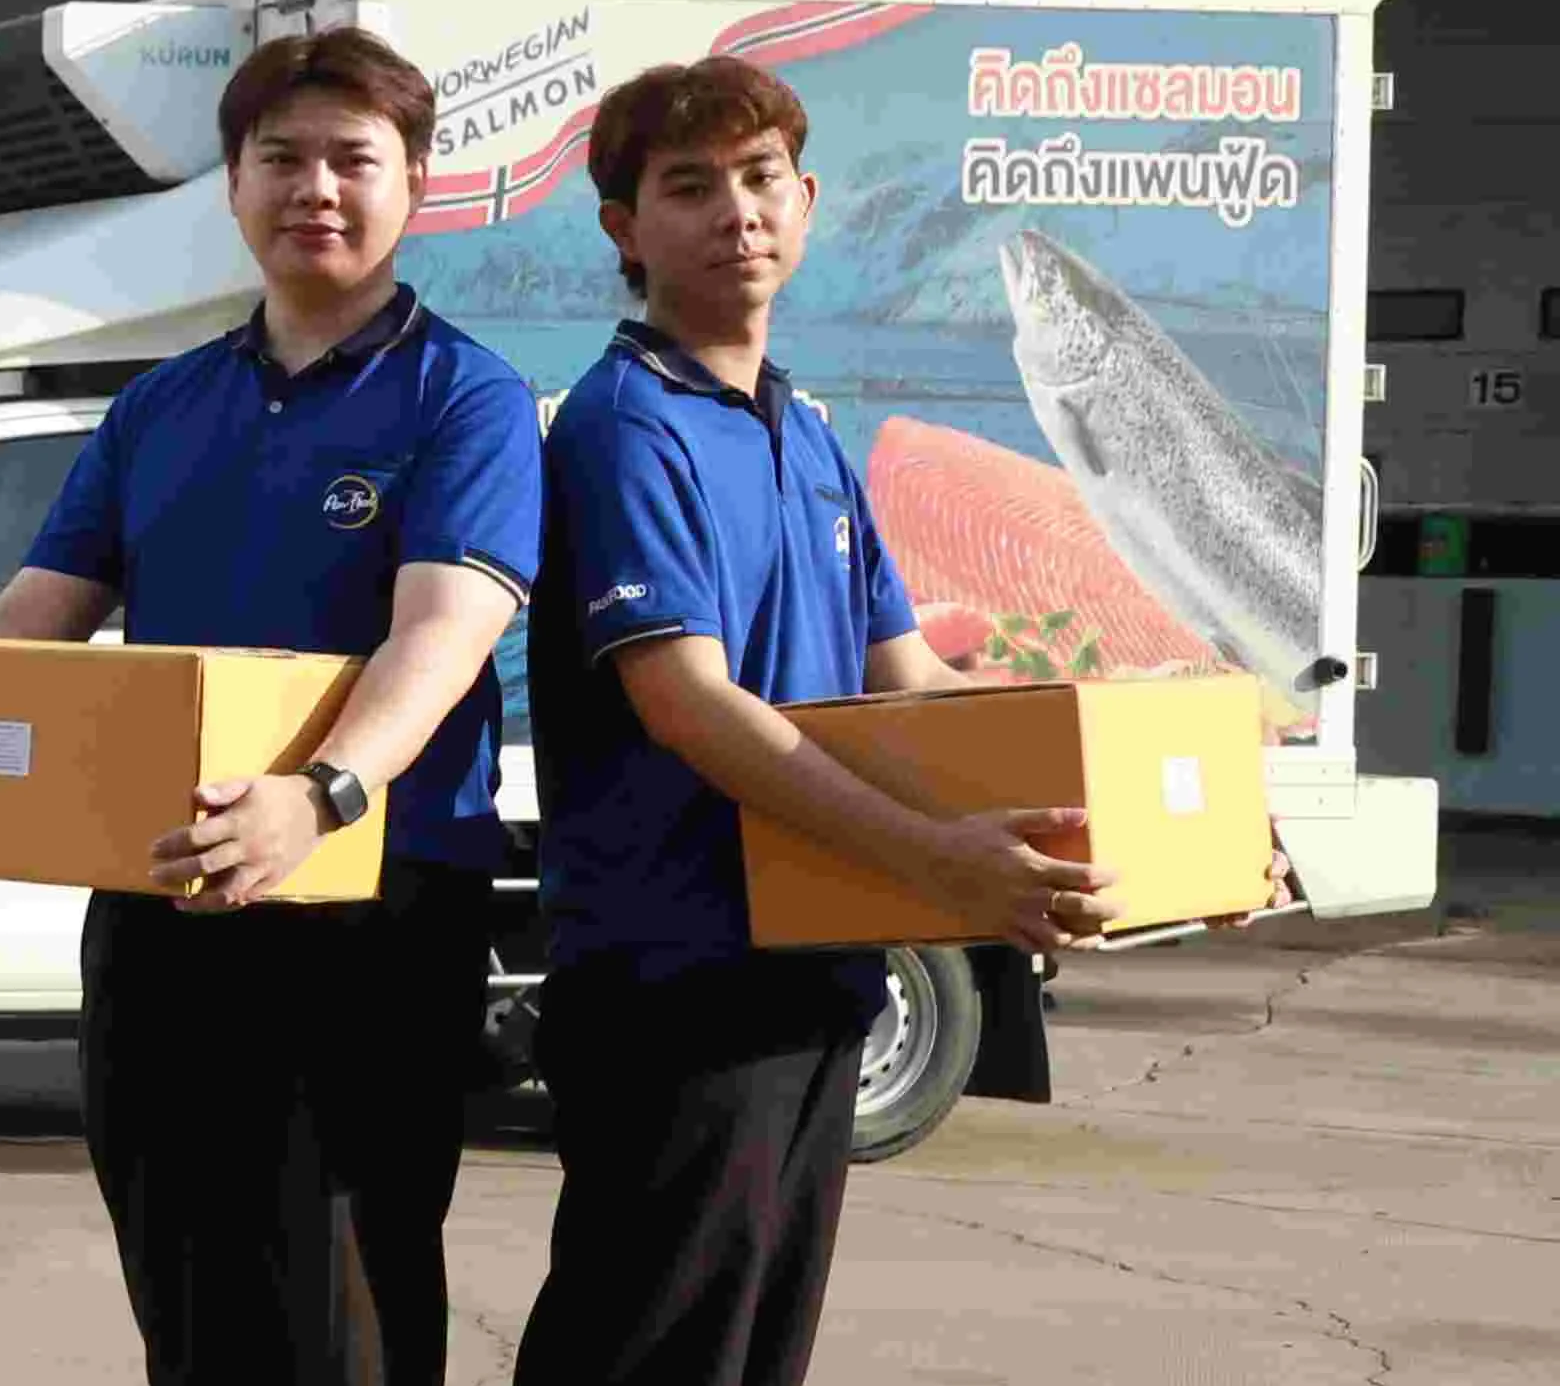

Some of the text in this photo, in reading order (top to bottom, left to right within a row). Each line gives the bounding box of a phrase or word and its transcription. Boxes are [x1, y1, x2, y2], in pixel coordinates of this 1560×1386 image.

[435, 64, 597, 155] SALMON
[970, 44, 1299, 119] คิดถึงแซลมอน
[965, 133, 1297, 225] คิดถึงแพนฟู้ด
[1473, 372, 1521, 405] 15
